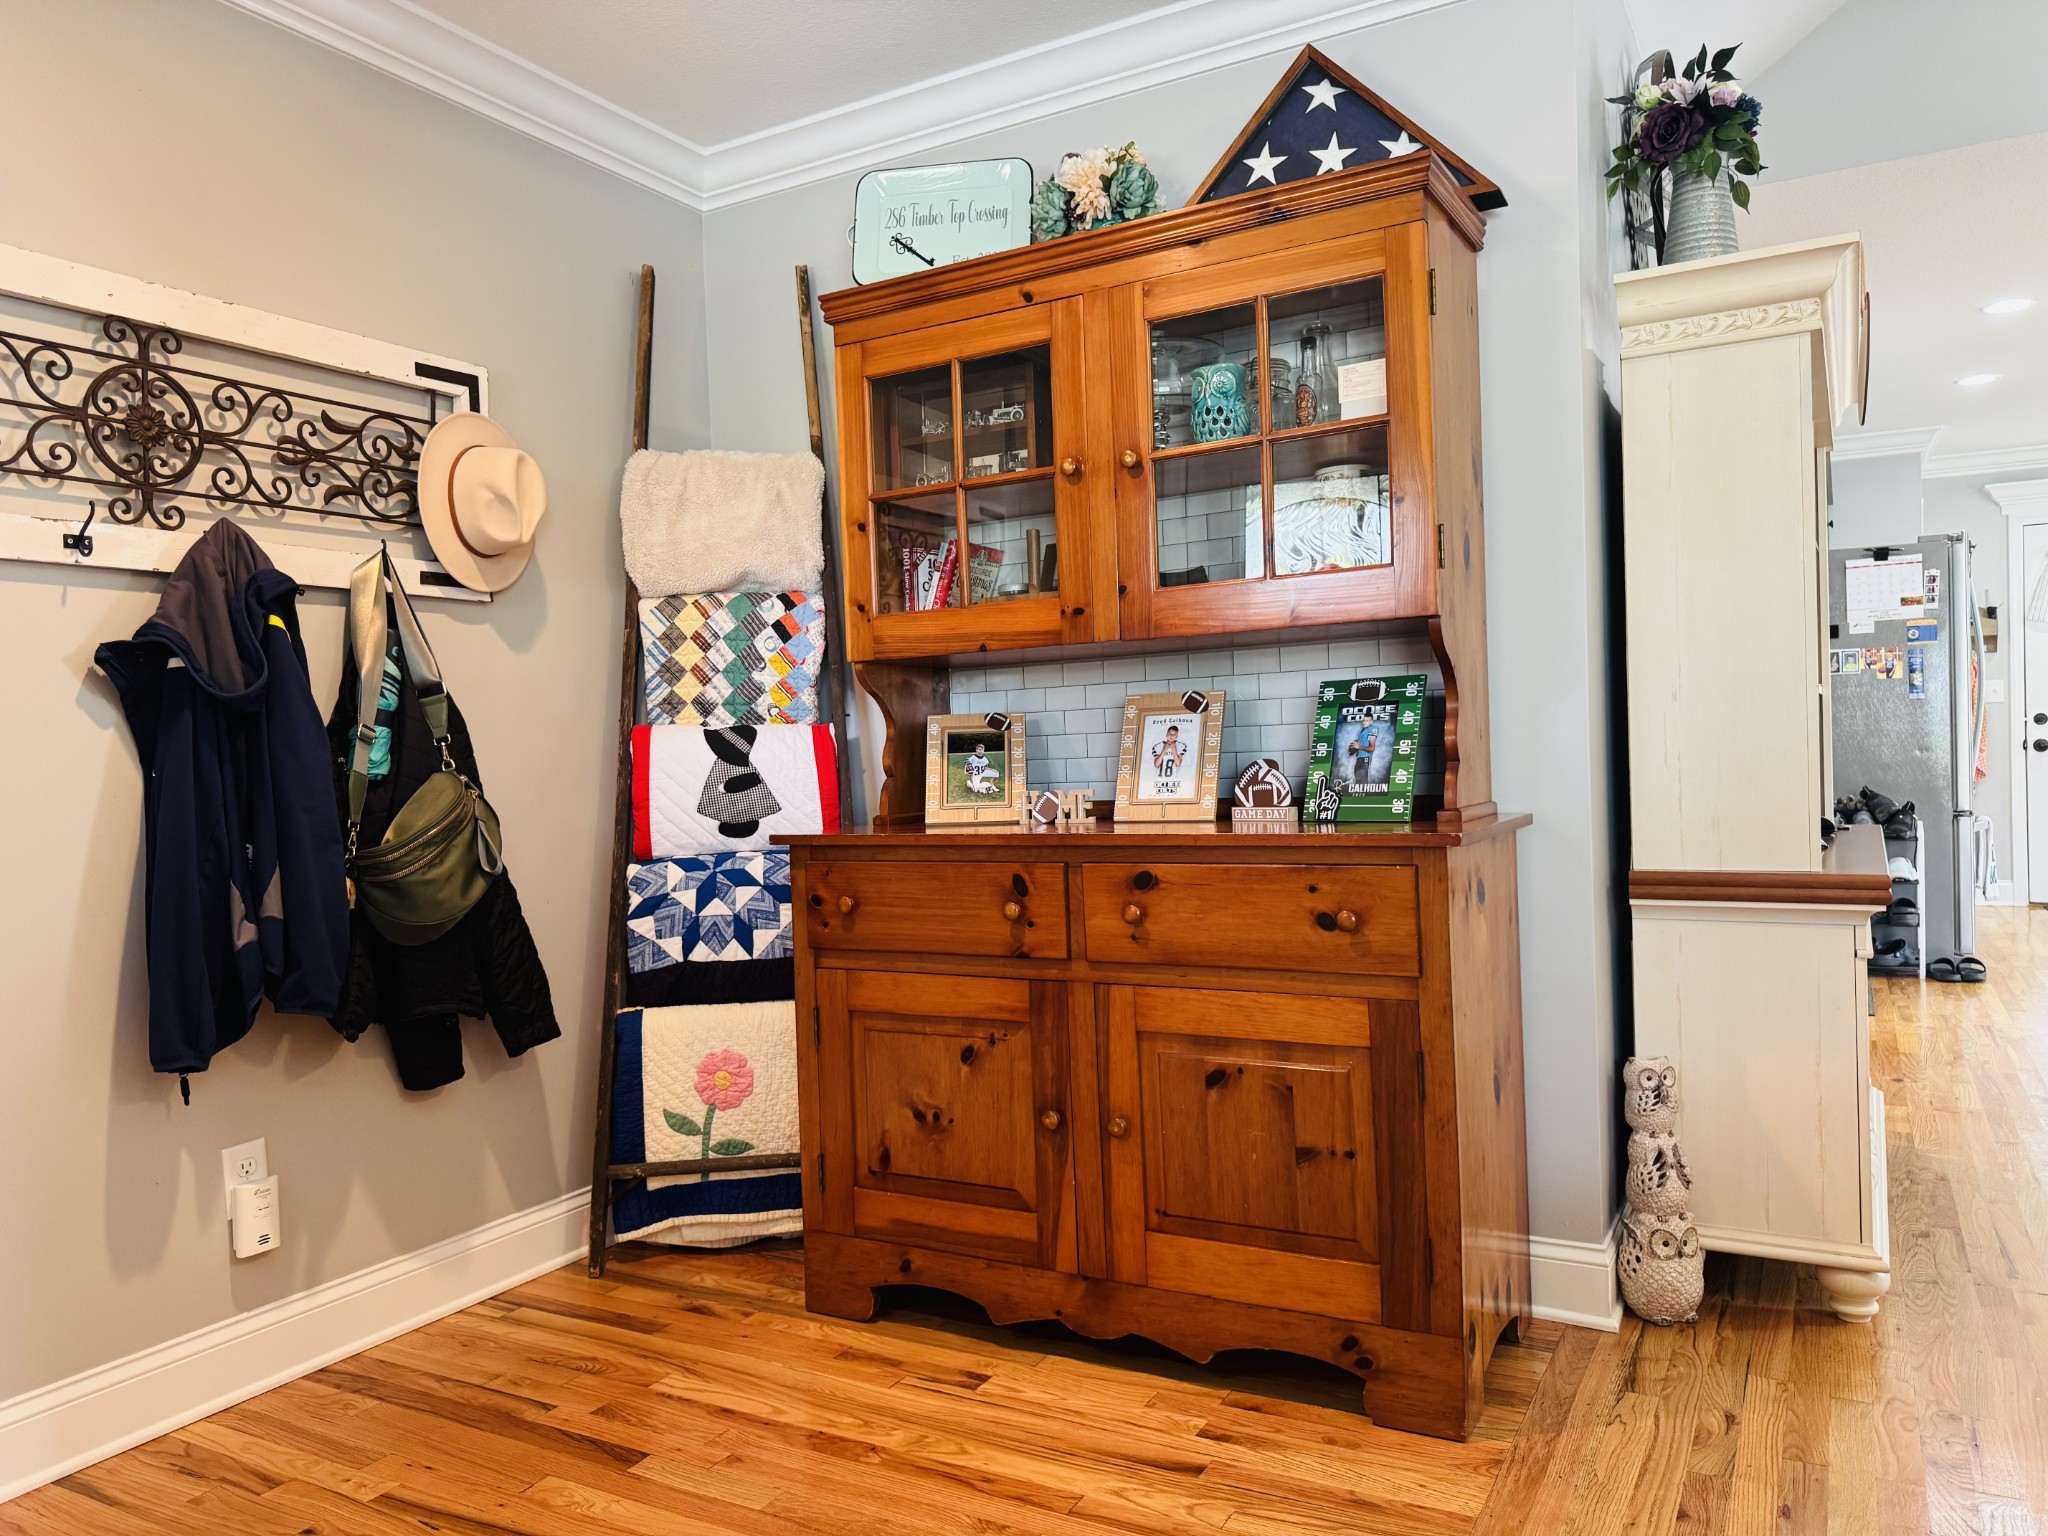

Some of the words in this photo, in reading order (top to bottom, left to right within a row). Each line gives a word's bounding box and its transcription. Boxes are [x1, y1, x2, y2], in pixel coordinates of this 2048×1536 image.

[909, 202, 944, 227] Timber
[946, 198, 964, 234] Top
[968, 199, 1008, 228] Crossing
[1323, 688, 1334, 702] 30
[1406, 682, 1418, 696] 30
[1127, 704, 1136, 718] 40
[1210, 702, 1220, 716] 10
[1320, 716, 1331, 729] 40
[1347, 713, 1390, 722] COTS
[1402, 710, 1414, 725] 40
[930, 723, 939, 736] 40
[1124, 734, 1133, 748] 30
[1208, 732, 1218, 746] 20
[930, 748, 938, 760] 30
[1014, 747, 1022, 758] 20
[1316, 743, 1328, 756] 50
[1398, 740, 1412, 754] 50
[1121, 764, 1130, 779] 20
[1206, 763, 1215, 778] 30
[1395, 768, 1408, 784] 40
[930, 775, 938, 786] 20
[1015, 772, 1023, 784] 30
[1348, 783, 1388, 792] CALHOUN
[1203, 794, 1213, 809] 40
[1392, 798, 1404, 813] 30
[1235, 810, 1263, 818] GAME
[1266, 810, 1286, 818] DAY
[1320, 811, 1331, 820] #1
